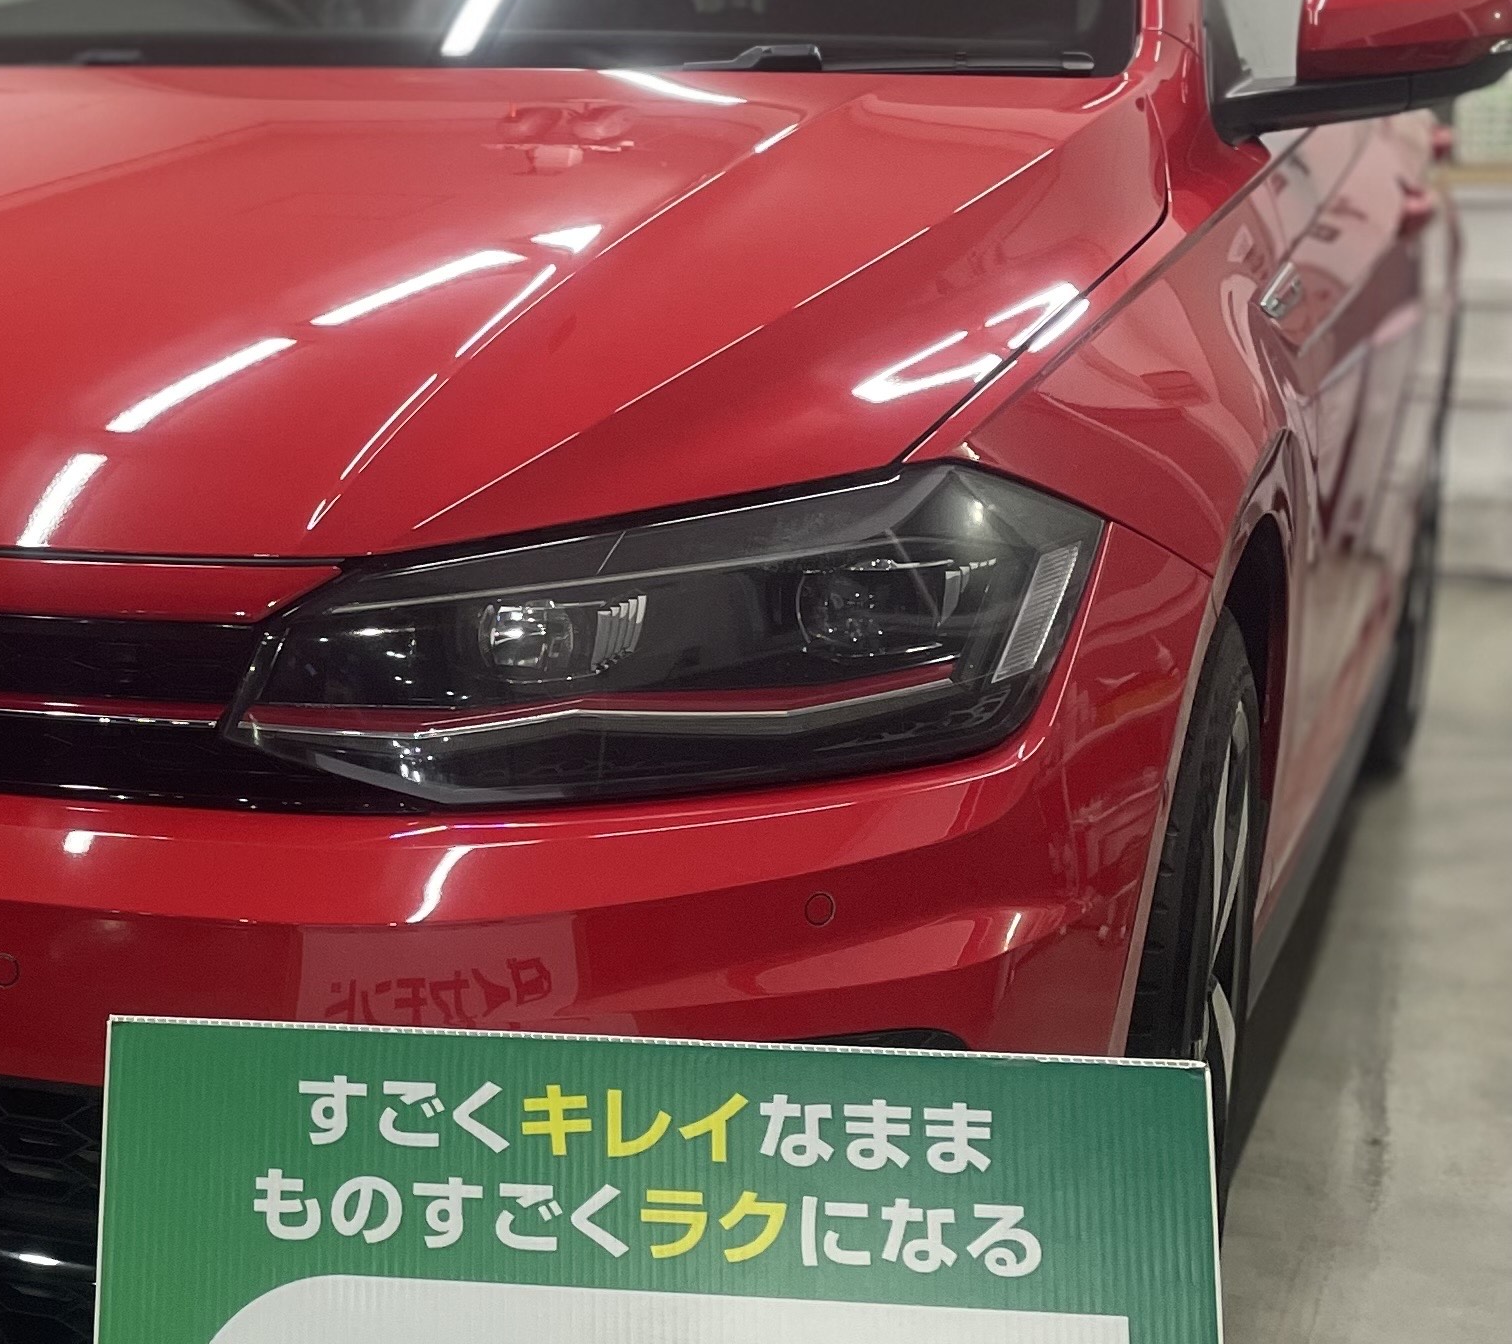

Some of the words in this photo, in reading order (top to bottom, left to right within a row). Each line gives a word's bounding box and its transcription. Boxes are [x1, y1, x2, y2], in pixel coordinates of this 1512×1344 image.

[297, 1073, 993, 1173] すごくキレイなまま
[252, 1169, 1043, 1278] ものすごくラクになる
